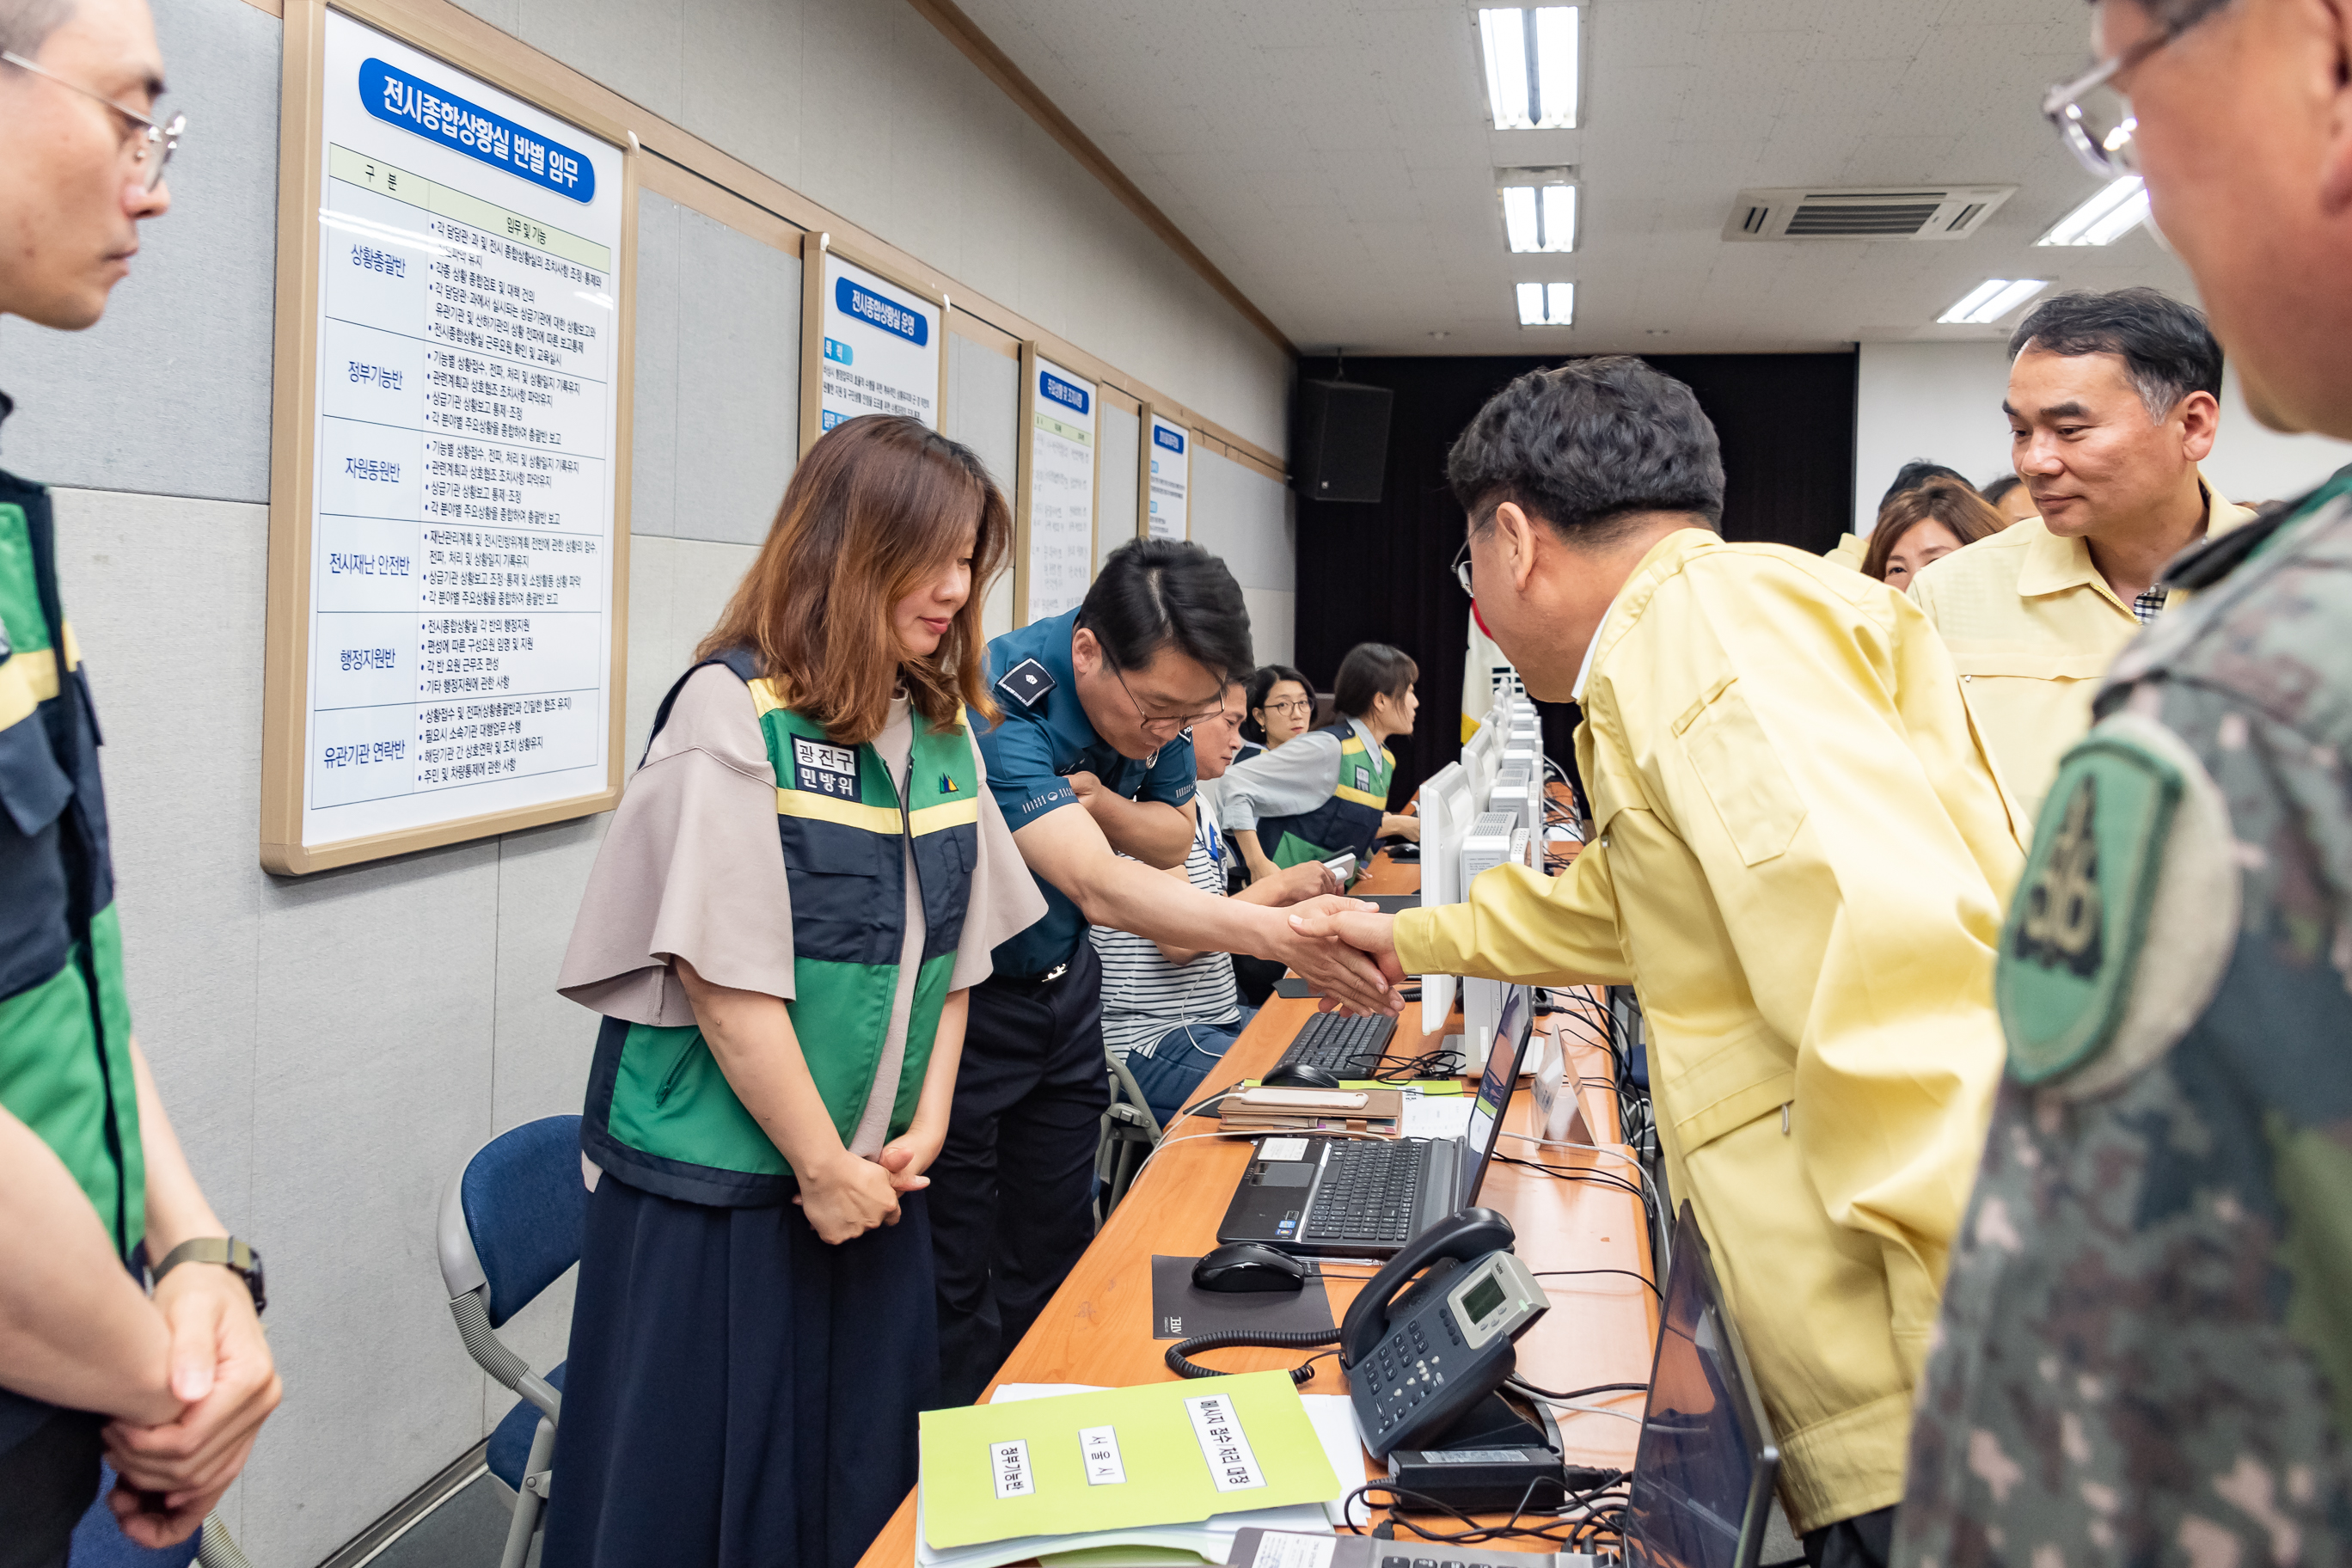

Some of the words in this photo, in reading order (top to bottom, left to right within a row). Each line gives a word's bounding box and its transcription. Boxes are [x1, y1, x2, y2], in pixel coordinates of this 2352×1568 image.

[383, 76, 509, 161] 전시종합상황실
[514, 133, 545, 176] 반별
[548, 150, 579, 188] 임무
[364, 163, 376, 183] 구
[386, 171, 397, 192] 분
[505, 217, 523, 236] 임무
[522, 222, 531, 241] 및
[531, 226, 547, 246] 기능
[350, 243, 407, 279] 상황총괄반
[436, 220, 445, 238] 각
[480, 236, 488, 252] 및
[488, 238, 504, 257] 전시
[543, 257, 569, 279] 조치사항
[467, 252, 483, 269] 유지
[435, 260, 451, 279] 각종
[451, 266, 468, 285] 상황
[468, 271, 497, 292] 종합검토
[498, 280, 505, 296] 및
[506, 283, 521, 301] 대책
[521, 287, 535, 304] 건의
[434, 281, 444, 297] 각
[491, 297, 519, 319] 실시되는
[519, 306, 552, 328] 상급기관에
[553, 315, 567, 332] 대한
[852, 290, 900, 329] 전시종합상황실
[901, 312, 915, 336] 운영
[435, 302, 465, 324] 유관기관
[466, 309, 475, 326] 및
[475, 313, 510, 335] 산하기관의
[510, 322, 525, 340] 상황
[524, 326, 545, 345] 전파에
[546, 332, 560, 348] 따른
[559, 335, 584, 354] 보고통제
[485, 334, 513, 355] 근무요원
[513, 341, 528, 358] 확인
[529, 346, 536, 361] 및
[536, 348, 562, 367] 교육실시
[347, 360, 403, 391] 정부기능반
[432, 350, 456, 370] 기능별
[505, 366, 520, 383] 처리
[521, 370, 529, 385] 및
[529, 372, 555, 390] 상황일지
[432, 370, 469, 392] 관련계획과
[469, 378, 499, 396] 상호협조
[499, 384, 527, 403] 조치사항
[527, 390, 553, 408] 파악유지
[432, 390, 462, 410] 상급기관
[462, 396, 492, 414] 상황보고
[432, 410, 440, 426] 각
[440, 412, 463, 431] 분야별
[464, 416, 499, 437] 주요상황을
[500, 422, 528, 441] 종합하여
[528, 427, 548, 444] 총괄반
[548, 432, 561, 445] 보고
[432, 440, 455, 457] 기능별
[505, 450, 519, 467] 처리
[520, 453, 528, 468] 및
[528, 454, 554, 471] 상황일지
[344, 457, 401, 483] 자원동원반
[431, 460, 469, 479] 관련계획과
[469, 465, 498, 481] 상호협조
[498, 469, 526, 486] 조치사항
[526, 473, 552, 488] 파악유지
[430, 480, 461, 498] 상급기관
[462, 484, 491, 499] 상황보고
[430, 500, 439, 516] 각
[439, 500, 462, 518] 분야별
[463, 504, 499, 521] 주요상황을
[499, 506, 526, 524] 종합하여
[527, 509, 547, 525] 총괄반
[547, 512, 560, 525] 보고
[475, 533, 482, 548] 및
[530, 536, 550, 551] 전반에
[551, 538, 564, 552] 관한
[328, 552, 376, 575] 전시재난
[377, 554, 410, 576] 안전반
[448, 550, 463, 566] 처리
[464, 551, 473, 567] 및
[473, 552, 502, 567] 상황일지
[428, 569, 459, 585] 상급기관
[459, 571, 488, 586] 상황보고
[521, 573, 528, 587] 및
[529, 573, 554, 588] 소방활동
[428, 590, 437, 605] 각
[437, 590, 460, 605] 분야별
[461, 591, 497, 606] 주요상황을
[497, 591, 524, 606] 종합하여
[525, 591, 545, 606] 총괄반
[545, 592, 559, 605] 보고
[479, 618, 487, 634] 각
[488, 618, 503, 633] 반의
[504, 618, 530, 633] 행정지원
[340, 647, 396, 671] 행정지원반
[426, 639, 450, 654] 편성에
[451, 638, 467, 653] 따른
[467, 637, 496, 653] 구성요원
[496, 637, 511, 652] 임명
[511, 637, 519, 652] 및
[519, 636, 534, 651] 지원
[426, 658, 435, 675] 각
[435, 658, 445, 674] 반
[444, 658, 462, 673] 요원
[462, 657, 484, 672] 근무조
[485, 657, 499, 671] 편성
[426, 678, 442, 695] 기타
[442, 677, 480, 694] 행정지원에
[480, 675, 495, 691] 관한
[495, 675, 510, 689] 사항
[425, 707, 456, 724] 상황접수
[456, 705, 464, 721] 및
[523, 699, 542, 714] 긴밀한
[543, 698, 556, 713] 협조
[425, 726, 448, 744] 필요시
[449, 724, 478, 740] 소속기관
[479, 720, 507, 738] 대행업무
[507, 719, 522, 734] 수행
[323, 743, 371, 769] 유관기관
[372, 738, 406, 763] 연락반
[424, 745, 455, 763] 해당기관
[456, 744, 464, 760] 간
[464, 741, 493, 759] 상호연락
[494, 740, 502, 755] 및
[502, 738, 517, 753] 조치
[517, 735, 543, 752] 상황유지
[799, 745, 853, 771] 광진구
[423, 768, 439, 784] 주민
[441, 766, 449, 782] 및
[450, 761, 486, 780] 차량통제에
[487, 759, 502, 775] 관한
[501, 756, 517, 772] 사항
[800, 767, 853, 796] 민방위
[1200, 1400, 1225, 1424] 메시지
[1210, 1428, 1242, 1464] 접수/처리
[1001, 1448, 1024, 1491] 정부기능반
[1227, 1467, 1250, 1485] 대장
